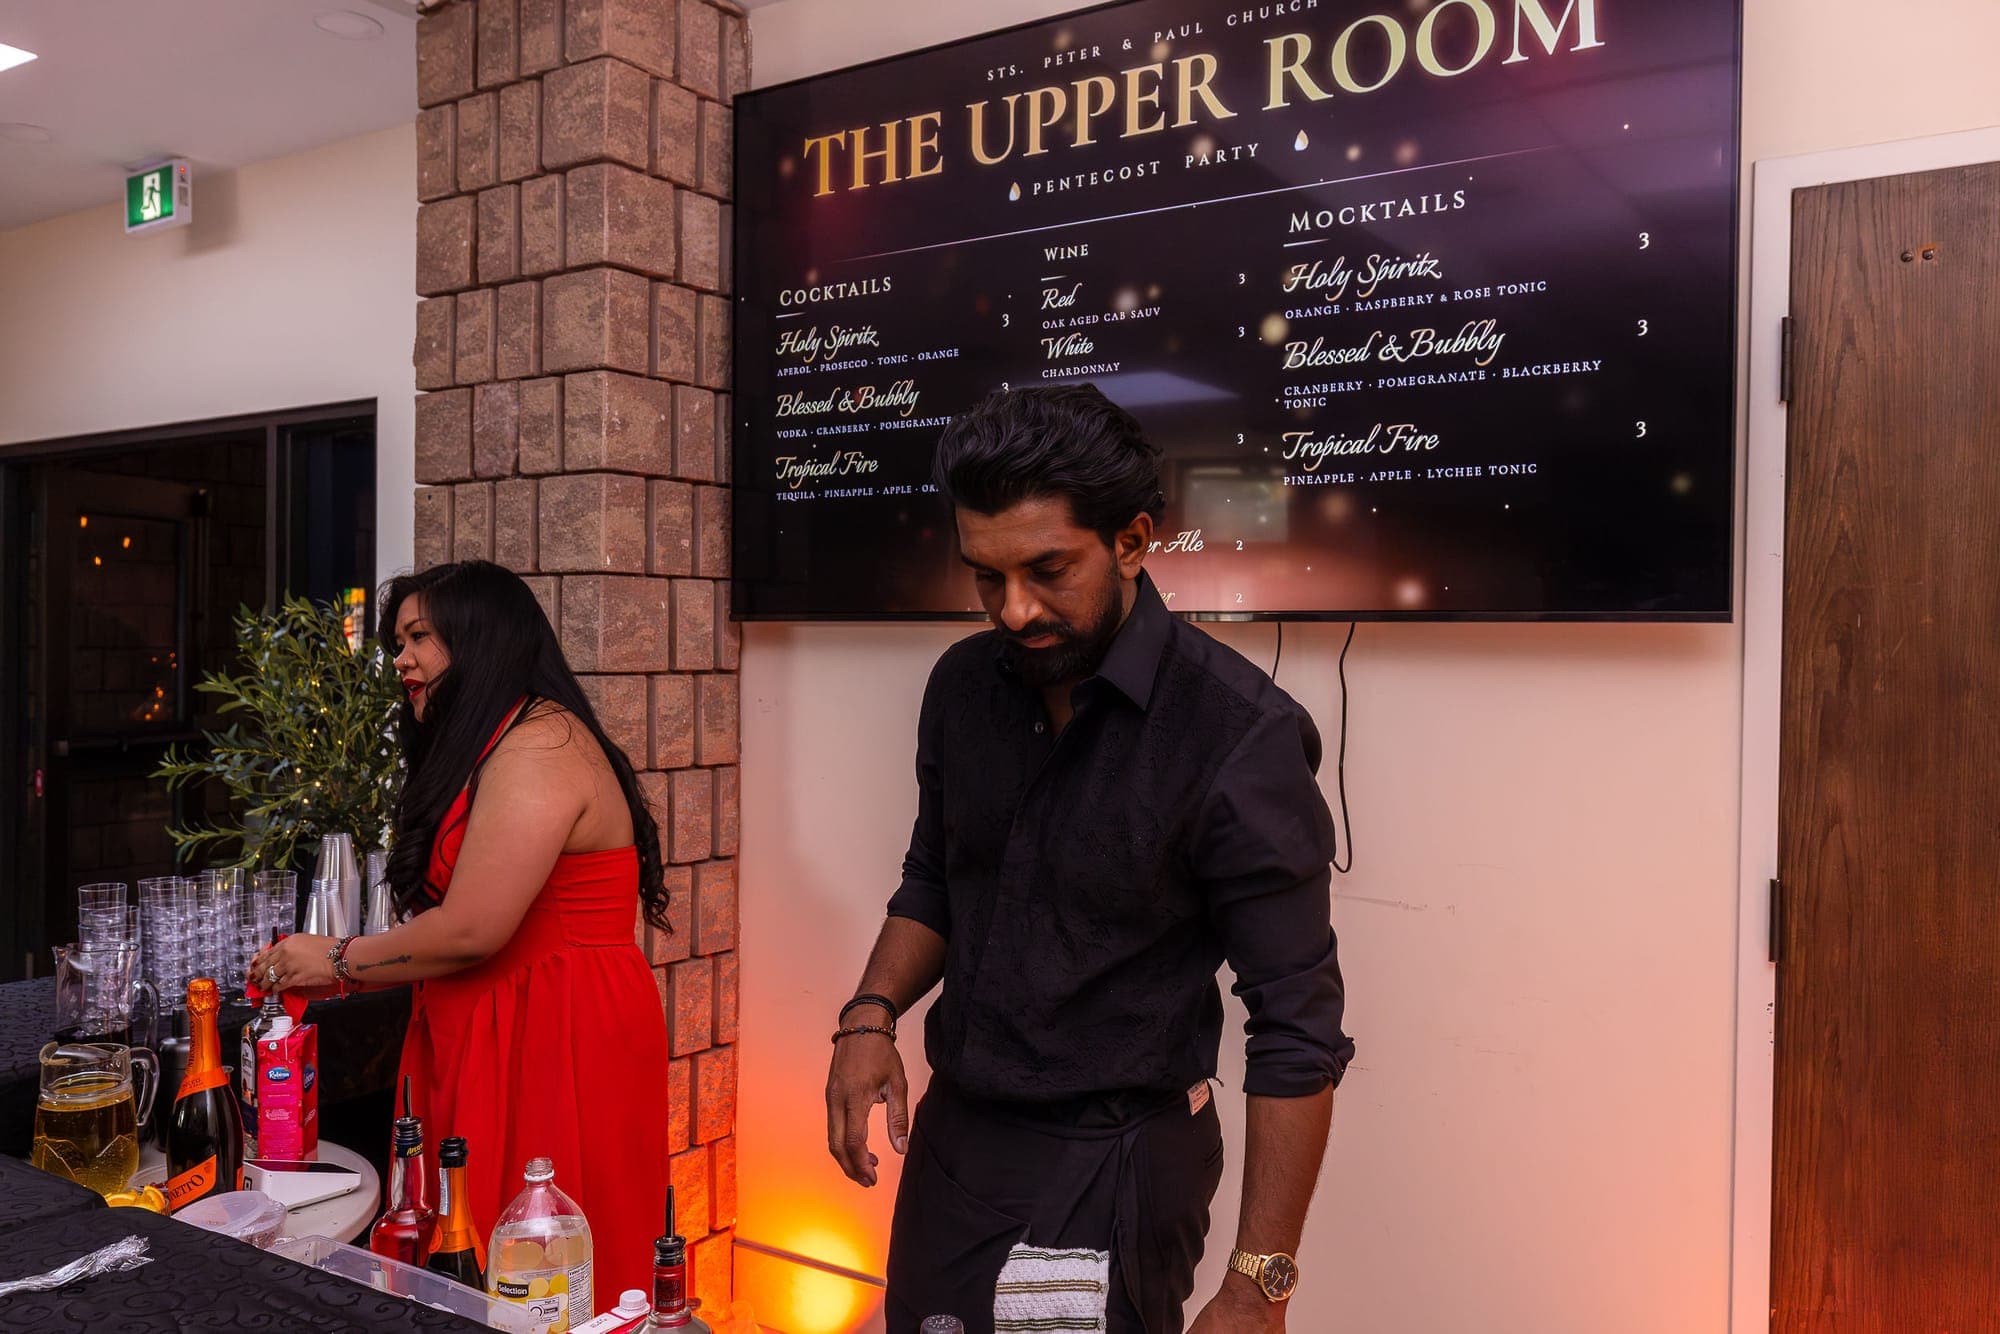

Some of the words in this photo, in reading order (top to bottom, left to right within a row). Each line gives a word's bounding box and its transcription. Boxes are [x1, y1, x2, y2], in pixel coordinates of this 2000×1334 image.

[987, 67, 1024, 81] STS.
[1044, 46, 1101, 69] PETER
[1122, 38, 1133, 50] &
[1154, 23, 1204, 43] PAUL
[1227, 0, 1318, 26] CHURCH
[804, 111, 943, 197] THE
[965, 53, 1237, 166] UPPER
[1262, 0, 1606, 111] ROOM
[1033, 161, 1160, 195] PENTECOST
[1185, 143, 1260, 168] PARTY
[1288, 189, 1467, 233] MOCKTAILS
[1044, 243, 1089, 262] WINE
[1638, 232, 1650, 250] 3
[1238, 273, 1246, 285] 3
[1283, 255, 1353, 302] Holy
[1357, 250, 1442, 298] Spiritz
[779, 276, 892, 306] COCKTAILS
[1041, 282, 1083, 311] Red
[1285, 303, 1341, 319] ORANGE
[1355, 293, 1434, 312] RASPBERRY
[1440, 294, 1449, 303] &
[1454, 287, 1491, 301] ROSE
[1498, 280, 1547, 297] TONIC
[1002, 313, 1010, 327] 3
[1042, 319, 1066, 329] OAK
[1070, 314, 1099, 326] AGED
[1104, 311, 1127, 322] CAB
[1131, 307, 1161, 319] SAUV
[1637, 319, 1648, 336] 3
[776, 326, 823, 363] Holy
[823, 324, 880, 361] Spiritz
[1238, 326, 1246, 338] 3
[1041, 333, 1094, 360] White
[1282, 331, 1383, 370] Blessed
[1379, 334, 1408, 363] &
[1408, 319, 1506, 367] Bubbly
[777, 366, 811, 377] APEROL
[820, 359, 868, 373] PROSECCO
[878, 354, 908, 366] TONIC
[918, 348, 960, 361] ORANGE
[1042, 361, 1121, 378] CHARDONNAY
[1284, 380, 1363, 396] CRANBERRY
[1378, 370, 1486, 389] POMEGRANATE
[1502, 360, 1603, 379] BLACKBERRY
[776, 386, 841, 417] Blessed
[838, 391, 857, 413] &
[856, 379, 920, 417] Bubbly
[1284, 396, 1328, 409] TONIC
[777, 429, 807, 439] VODKA
[816, 423, 870, 436] CRANBERRY
[1237, 433, 1245, 445] 3
[1635, 421, 1647, 438] 3
[1282, 423, 1381, 472] Tropical
[1379, 423, 1441, 453] Fire
[776, 450, 840, 489] Tropical
[839, 451, 878, 475] Fire
[1283, 472, 1355, 486] PINEAPPLE
[1369, 470, 1412, 481] APPLE
[1427, 466, 1482, 479] LYCHEE
[1488, 463, 1538, 476] TONIC
[776, 491, 815, 502] TEQUILA
[824, 488, 874, 498] PINEAPPLE
[883, 485, 912, 495] APPLE
[1164, 528, 1204, 553] Ale
[1235, 539, 1243, 551] 2
[1235, 592, 1243, 604] 2
[498, 1283, 528, 1295] Selection
